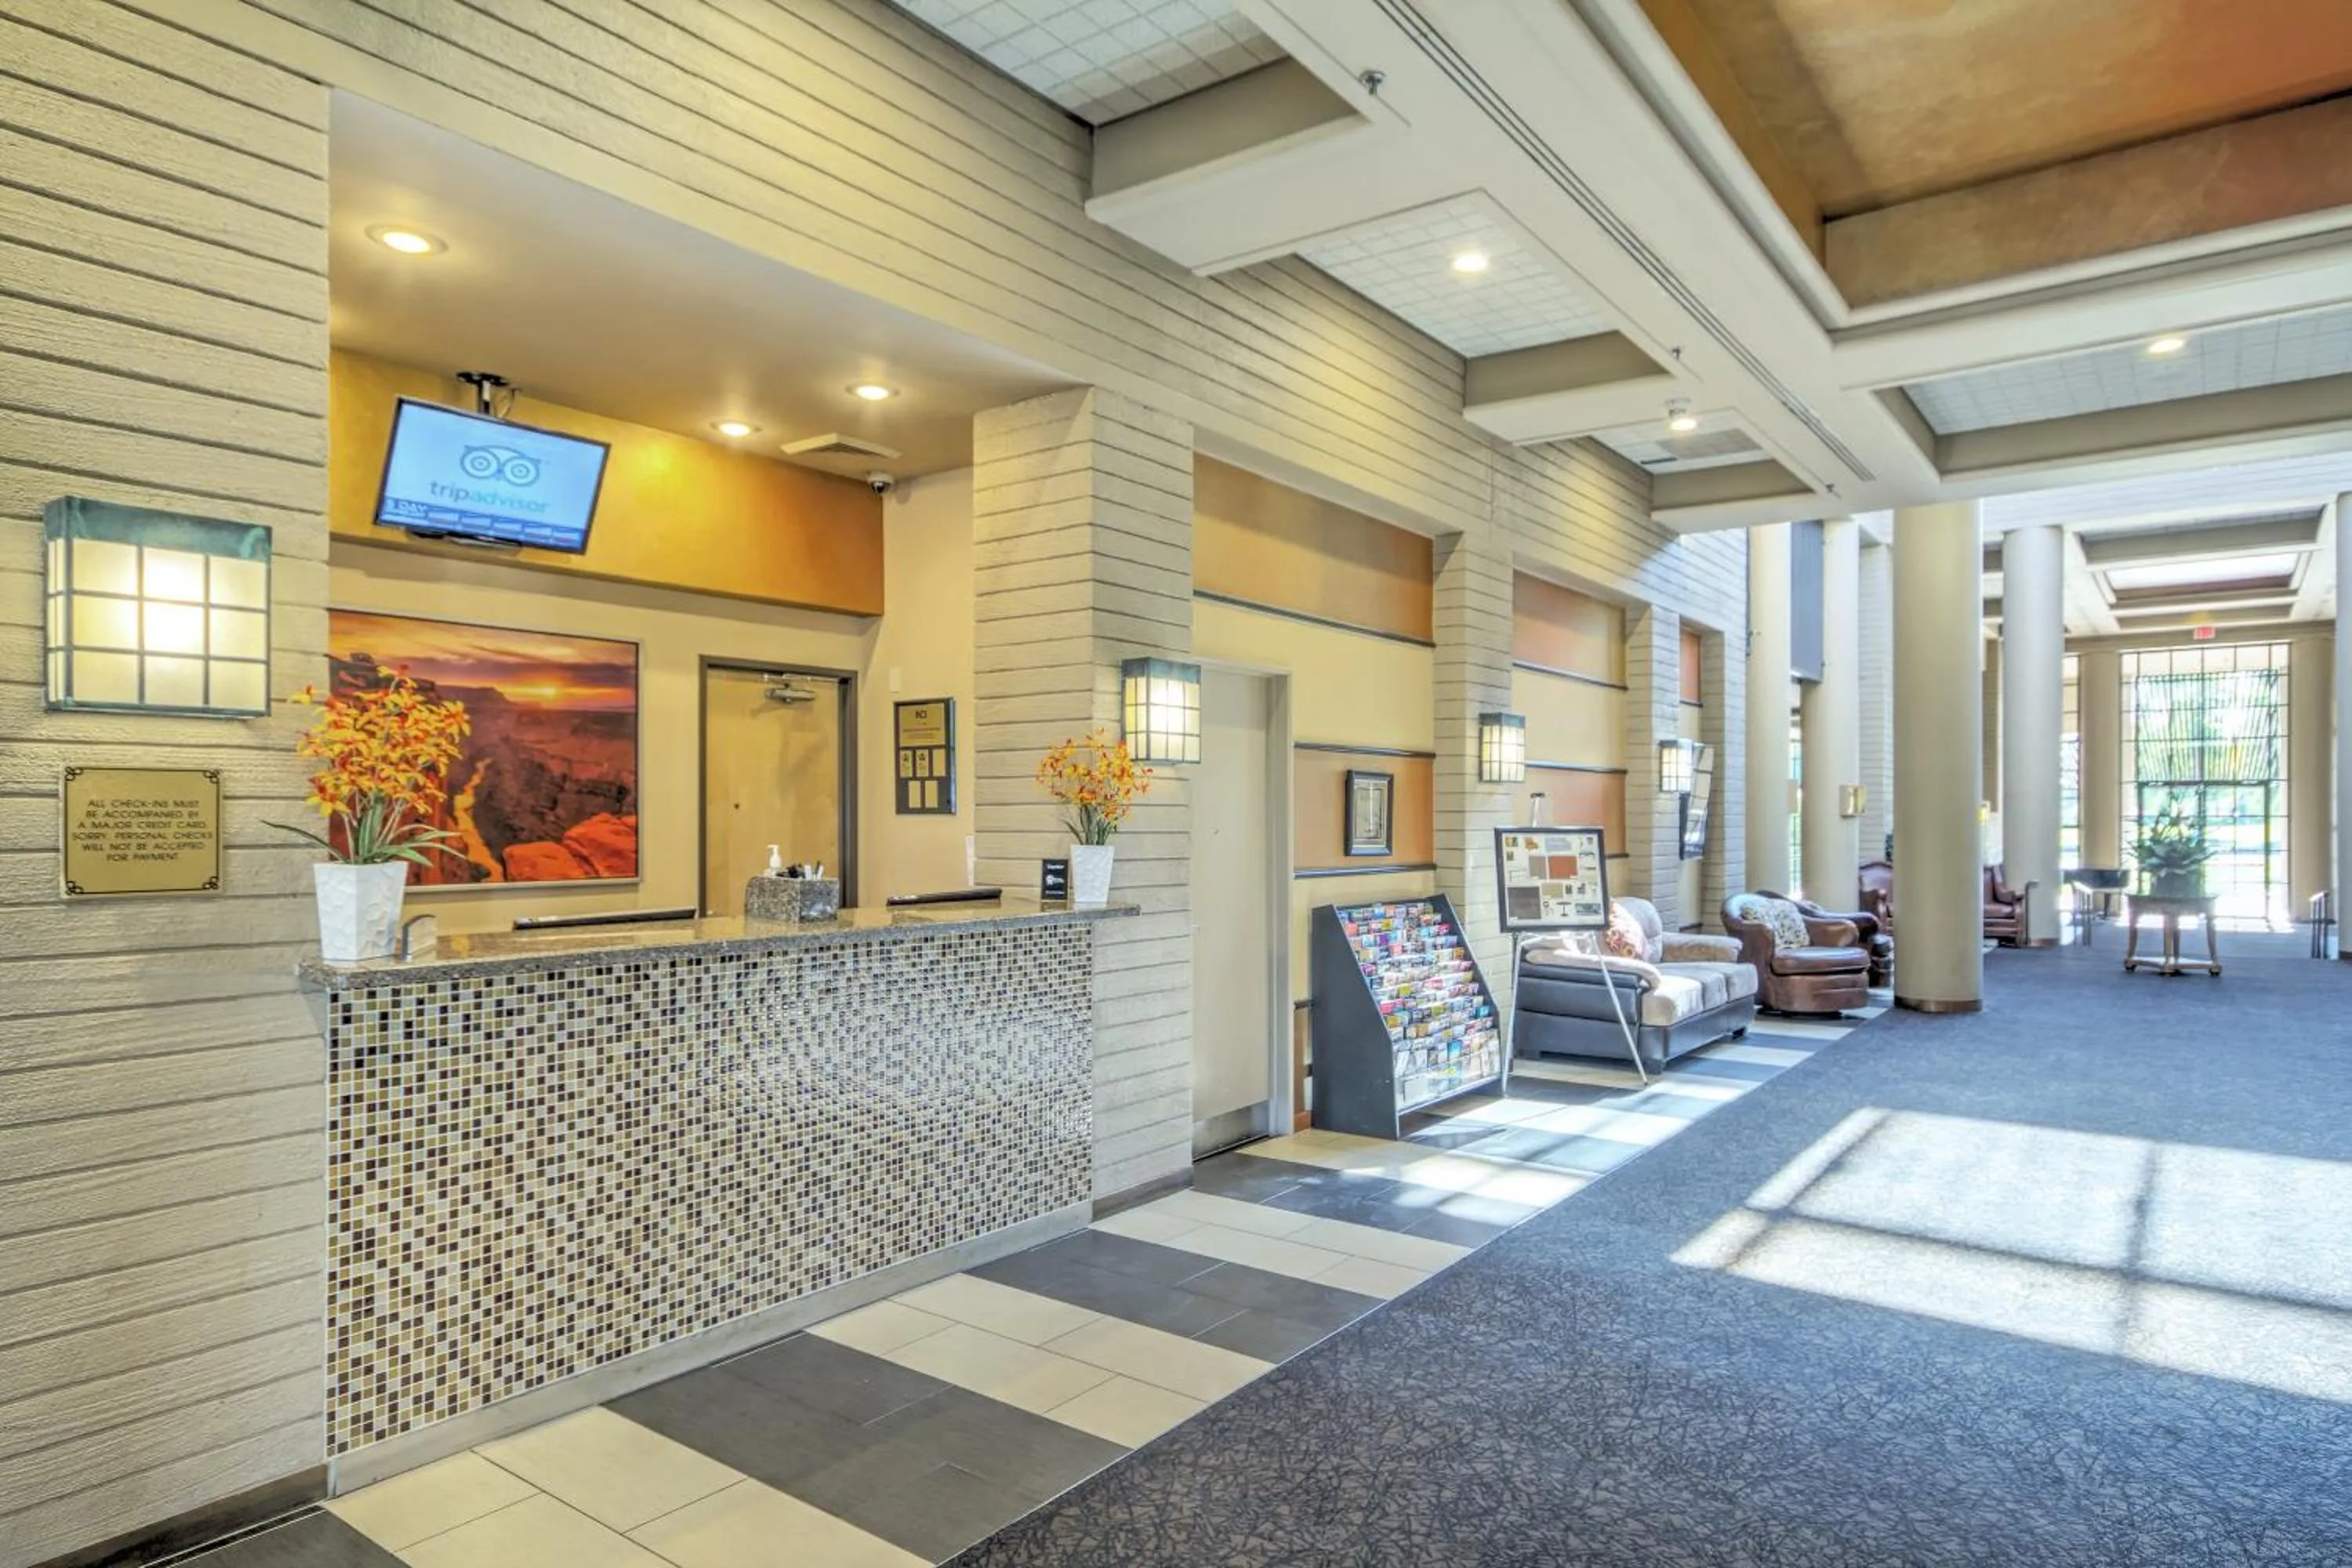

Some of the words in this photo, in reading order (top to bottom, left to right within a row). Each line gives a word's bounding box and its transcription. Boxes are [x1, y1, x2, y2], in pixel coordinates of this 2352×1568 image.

[429, 480, 550, 514] tripadvisor
[111, 799, 168, 808] CHECK-INS
[86, 810, 98, 818] BE
[103, 810, 183, 818] ACCOMPANIED
[82, 843, 103, 851] WILL
[154, 842, 205, 851] ACCEPTED
[106, 853, 129, 862] FOR
